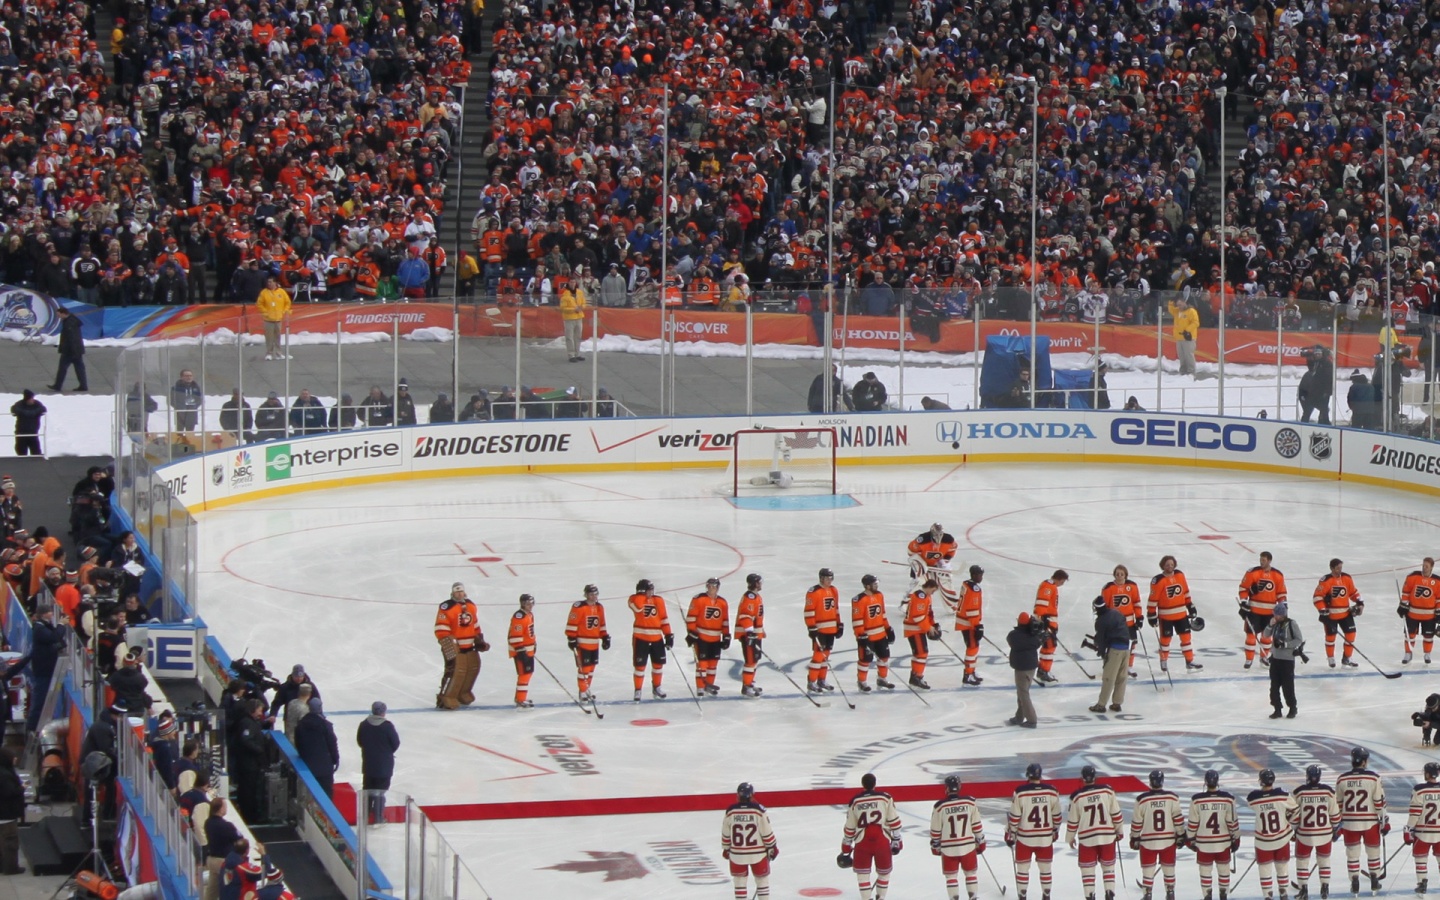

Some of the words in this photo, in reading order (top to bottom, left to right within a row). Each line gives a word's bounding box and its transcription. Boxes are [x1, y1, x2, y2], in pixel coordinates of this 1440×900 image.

[345, 313, 425, 325] BRIDGESTONE
[666, 321, 728, 335] DISCOVER
[847, 330, 916, 342] HONDA
[658, 430, 738, 452] verizon
[817, 425, 908, 449] CANADIAN
[966, 422, 1097, 440] HONDA
[1110, 417, 1257, 453] GEICO
[269, 443, 400, 471] enterprise
[413, 434, 572, 458] BRIDGESTONE
[233, 465, 253, 477] NBC
[534, 734, 601, 777] verizon
[1344, 789, 1369, 812] 22
[1027, 804, 1050, 828] 41
[1083, 802, 1107, 827] 71
[1153, 809, 1166, 831] 8
[1206, 811, 1220, 834] 4
[1259, 811, 1281, 834] 18
[1303, 805, 1328, 828] 26
[732, 824, 757, 846] 62
[947, 814, 968, 839] 17
